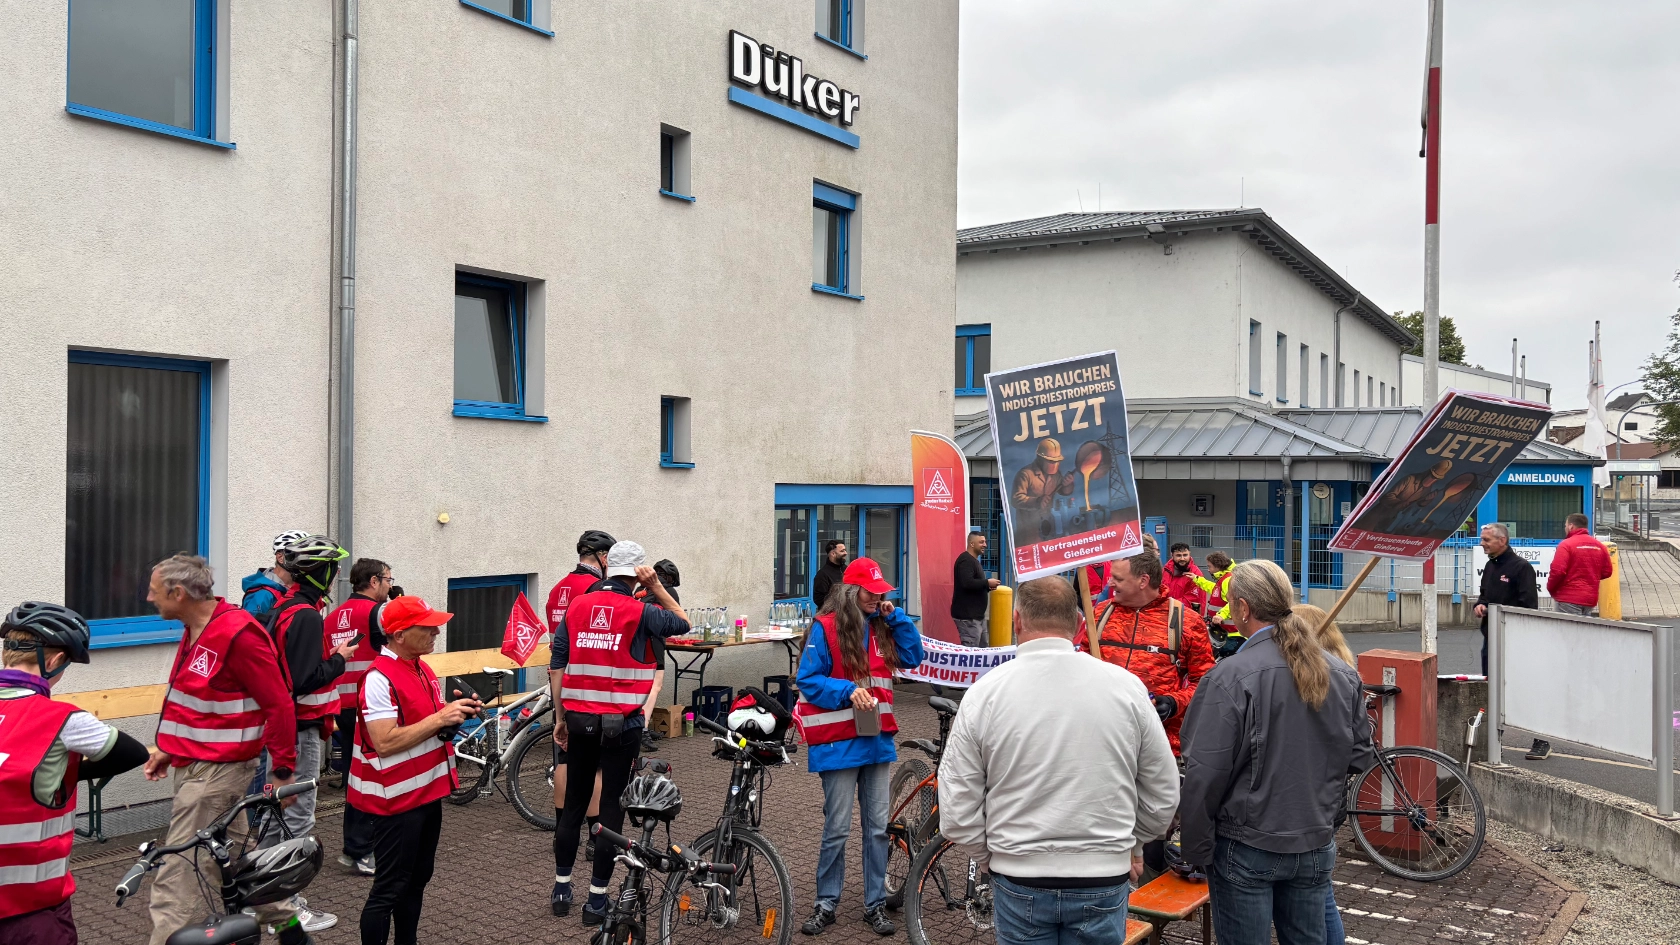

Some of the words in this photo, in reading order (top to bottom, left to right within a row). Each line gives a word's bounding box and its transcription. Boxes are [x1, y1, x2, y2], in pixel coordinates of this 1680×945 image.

[730, 30, 859, 125] Düker
[999, 379, 1030, 398] WIR
[1034, 363, 1111, 392] BRAUCHEN
[1002, 380, 1116, 412] INDUSTRIESTROMPREIS
[1013, 396, 1106, 442] JETZT
[1451, 405, 1480, 423] WIR
[1476, 411, 1541, 432] BRAUCHEN
[1441, 420, 1533, 442] INDUSTRIESTROMPREIS
[1425, 433, 1514, 464] JETZT
[1507, 473, 1575, 483] ANMELDUNG
[1042, 530, 1117, 553] Vertrauensleute
[1063, 543, 1103, 559] Gießerei
[1365, 534, 1423, 546] Vertrauensleute
[1373, 543, 1405, 553] Gießerei
[577, 631, 615, 641] SOLIDARITÄT
